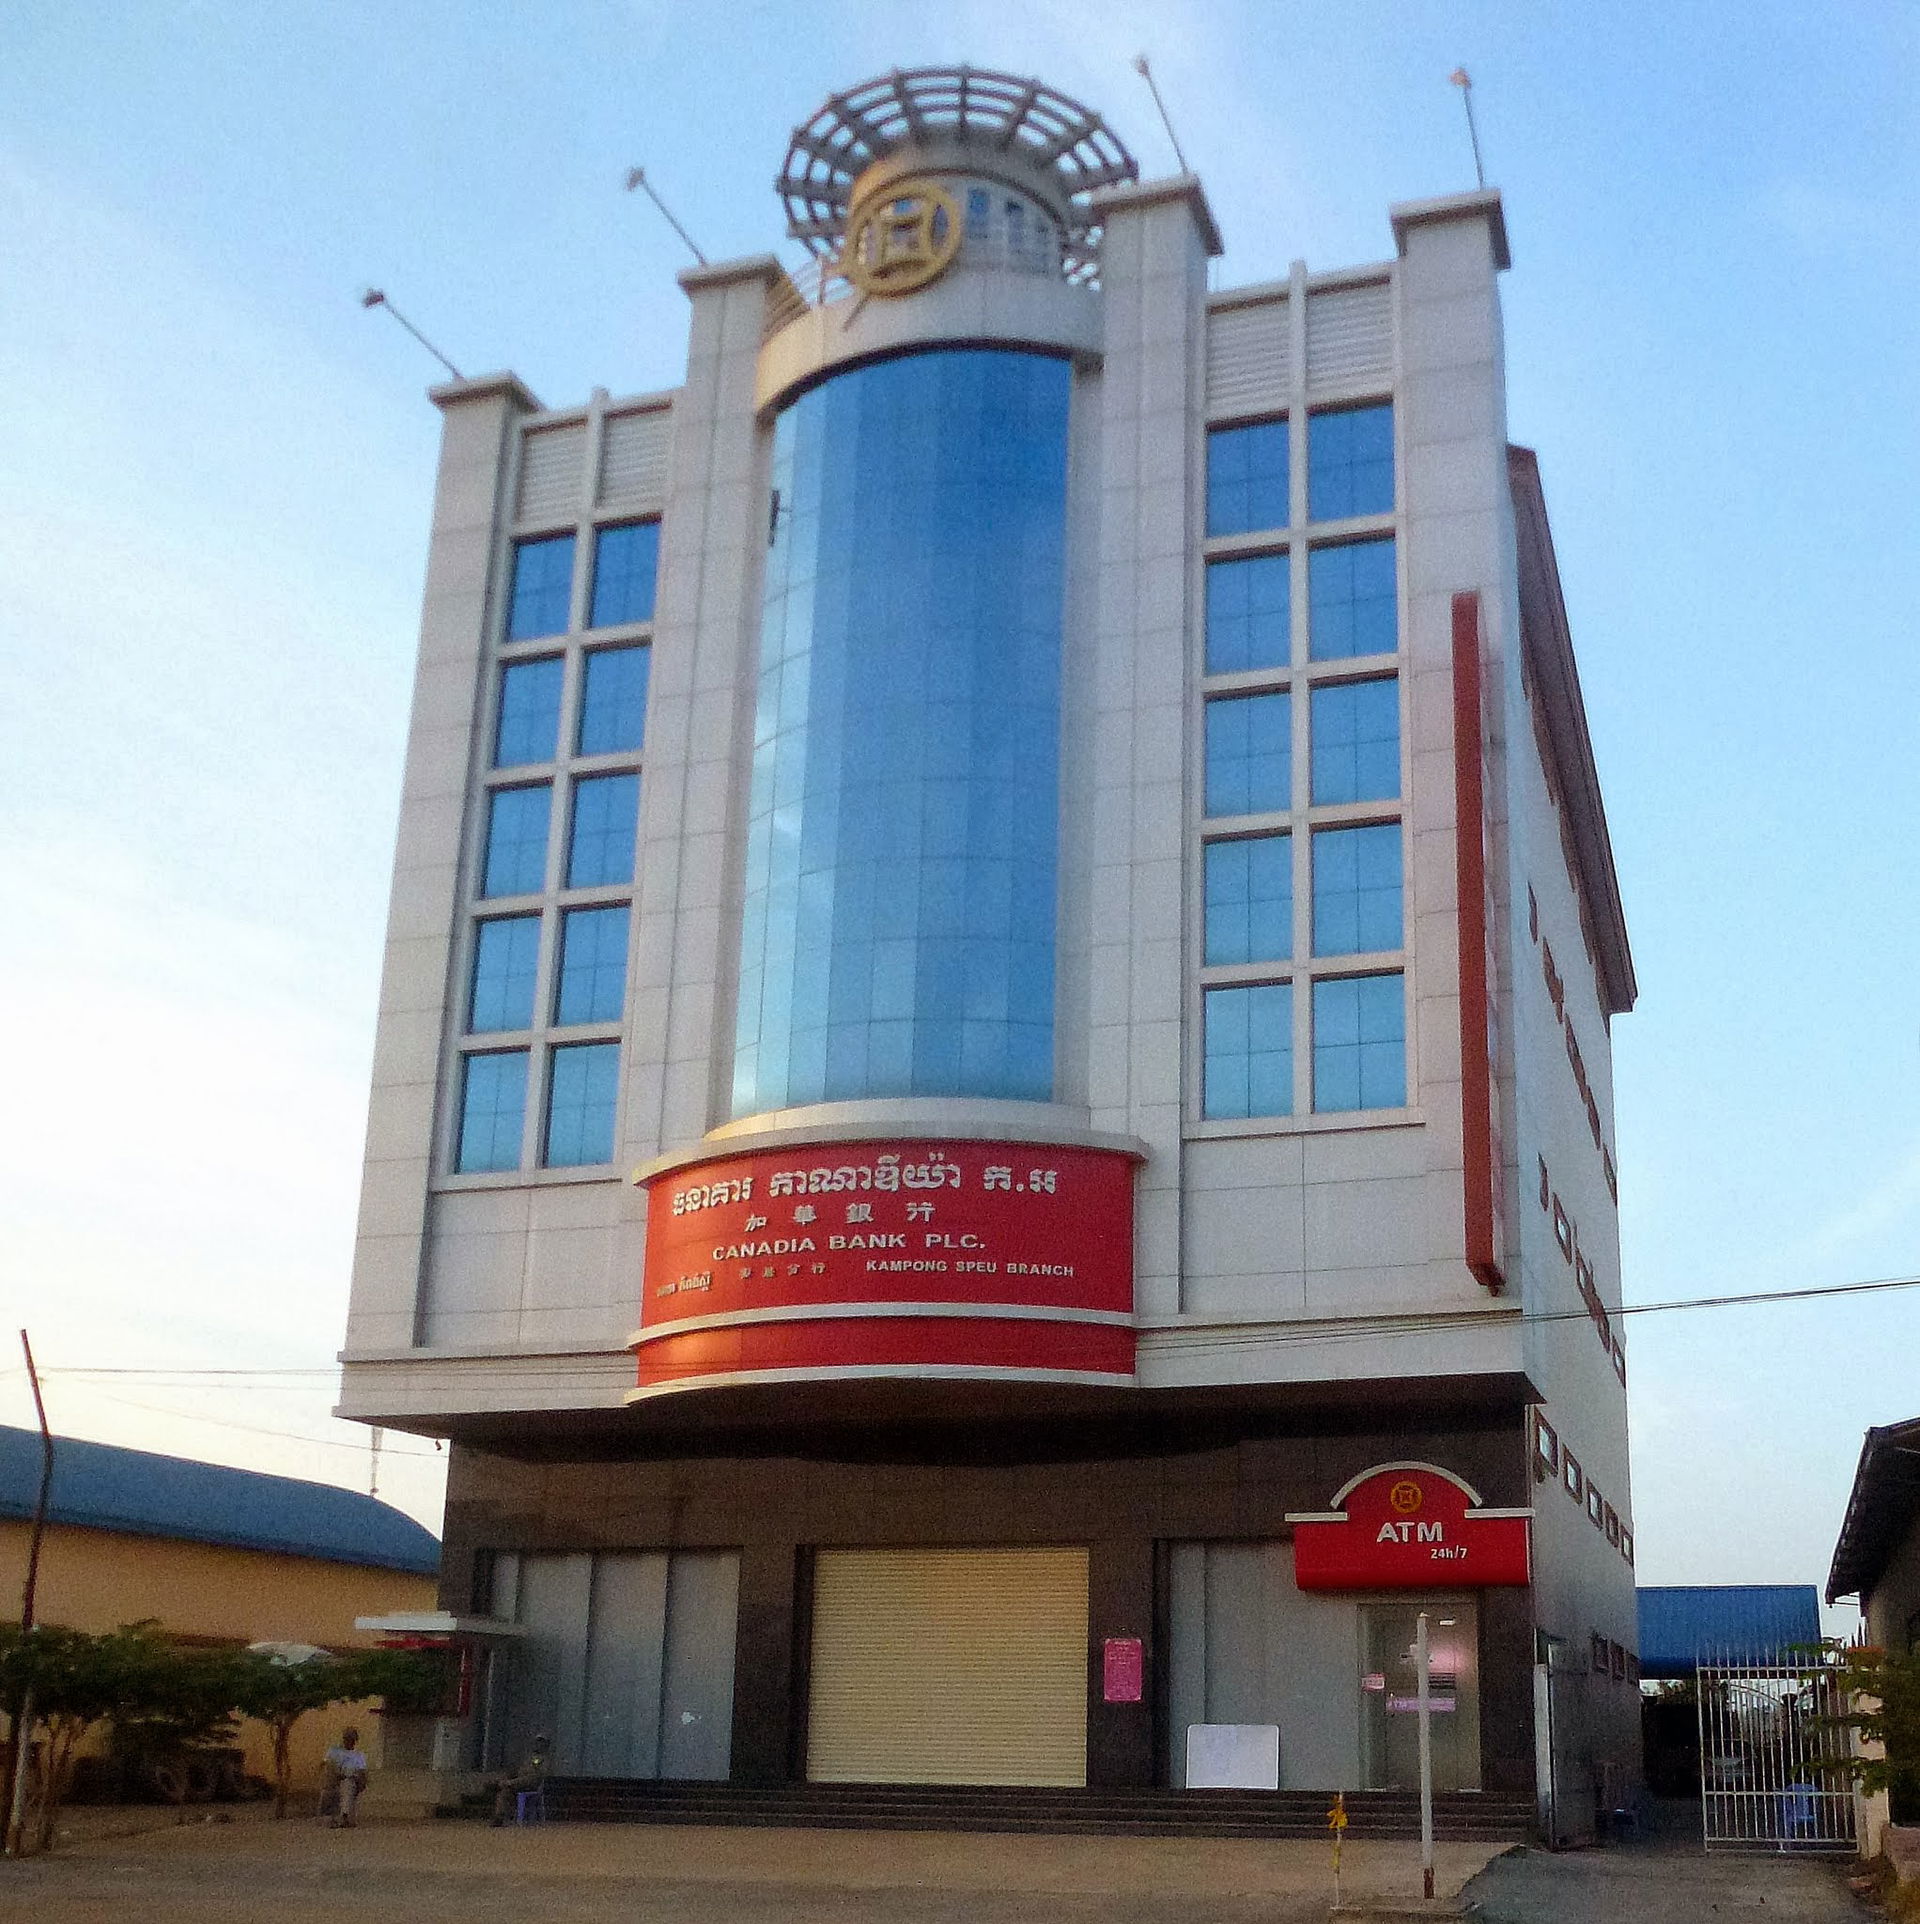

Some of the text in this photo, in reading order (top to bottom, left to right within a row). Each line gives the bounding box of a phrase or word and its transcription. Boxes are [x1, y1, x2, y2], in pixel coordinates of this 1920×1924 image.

[672, 1177, 754, 1216] ធនាគារ
[711, 1233, 986, 1261] CANADIA BANK PLC.
[866, 1260, 1075, 1278] KAMPONG SPEU BRANCH
[1376, 1521, 1443, 1543] ATM
[1430, 1544, 1468, 1560] 24h/7
